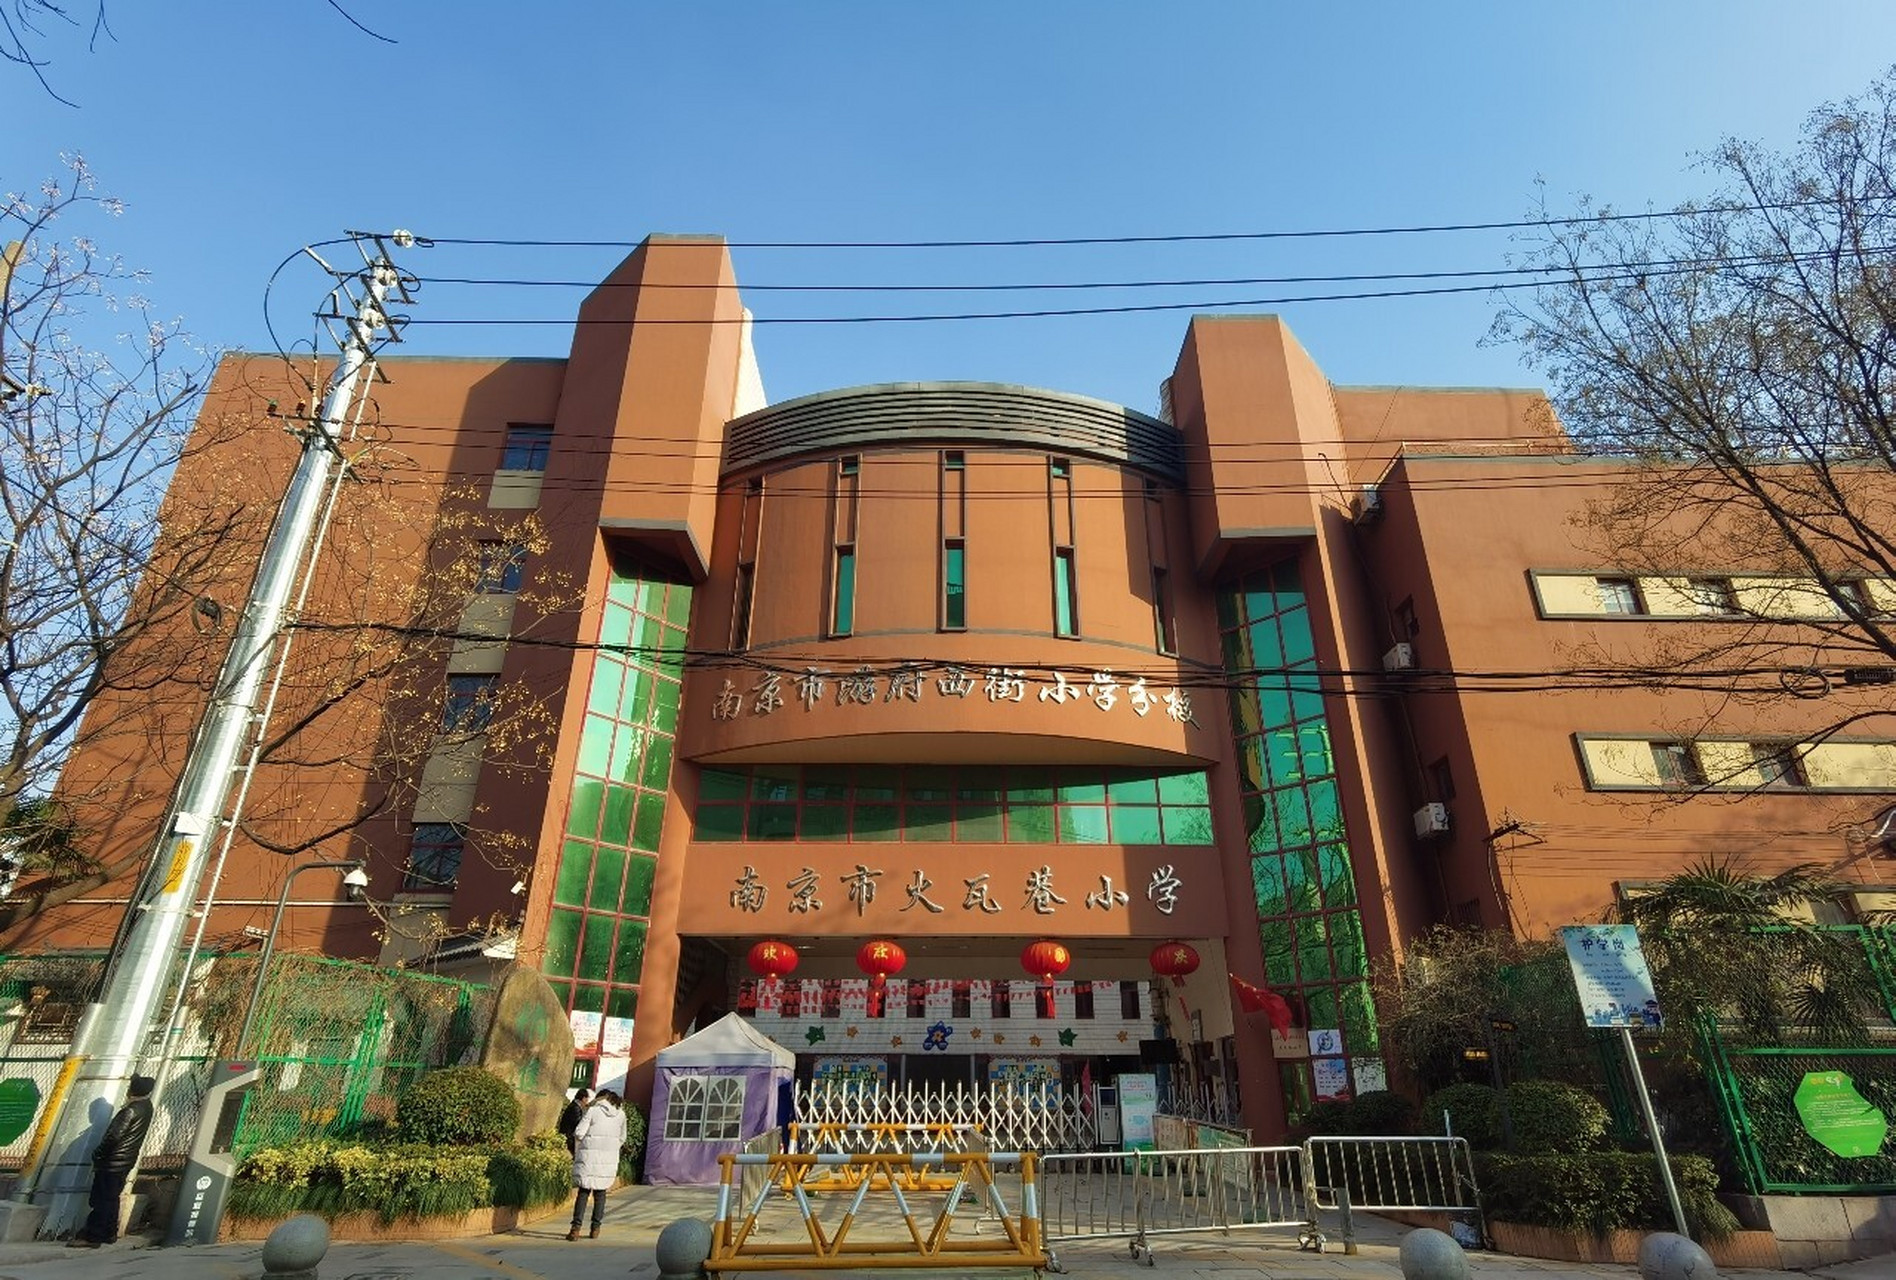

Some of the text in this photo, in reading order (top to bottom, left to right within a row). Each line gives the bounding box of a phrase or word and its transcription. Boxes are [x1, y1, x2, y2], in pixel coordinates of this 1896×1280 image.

[712, 664, 1200, 729] 南京市游府西街小学分校
[729, 864, 1183, 916] 南京市火瓦巷小学
